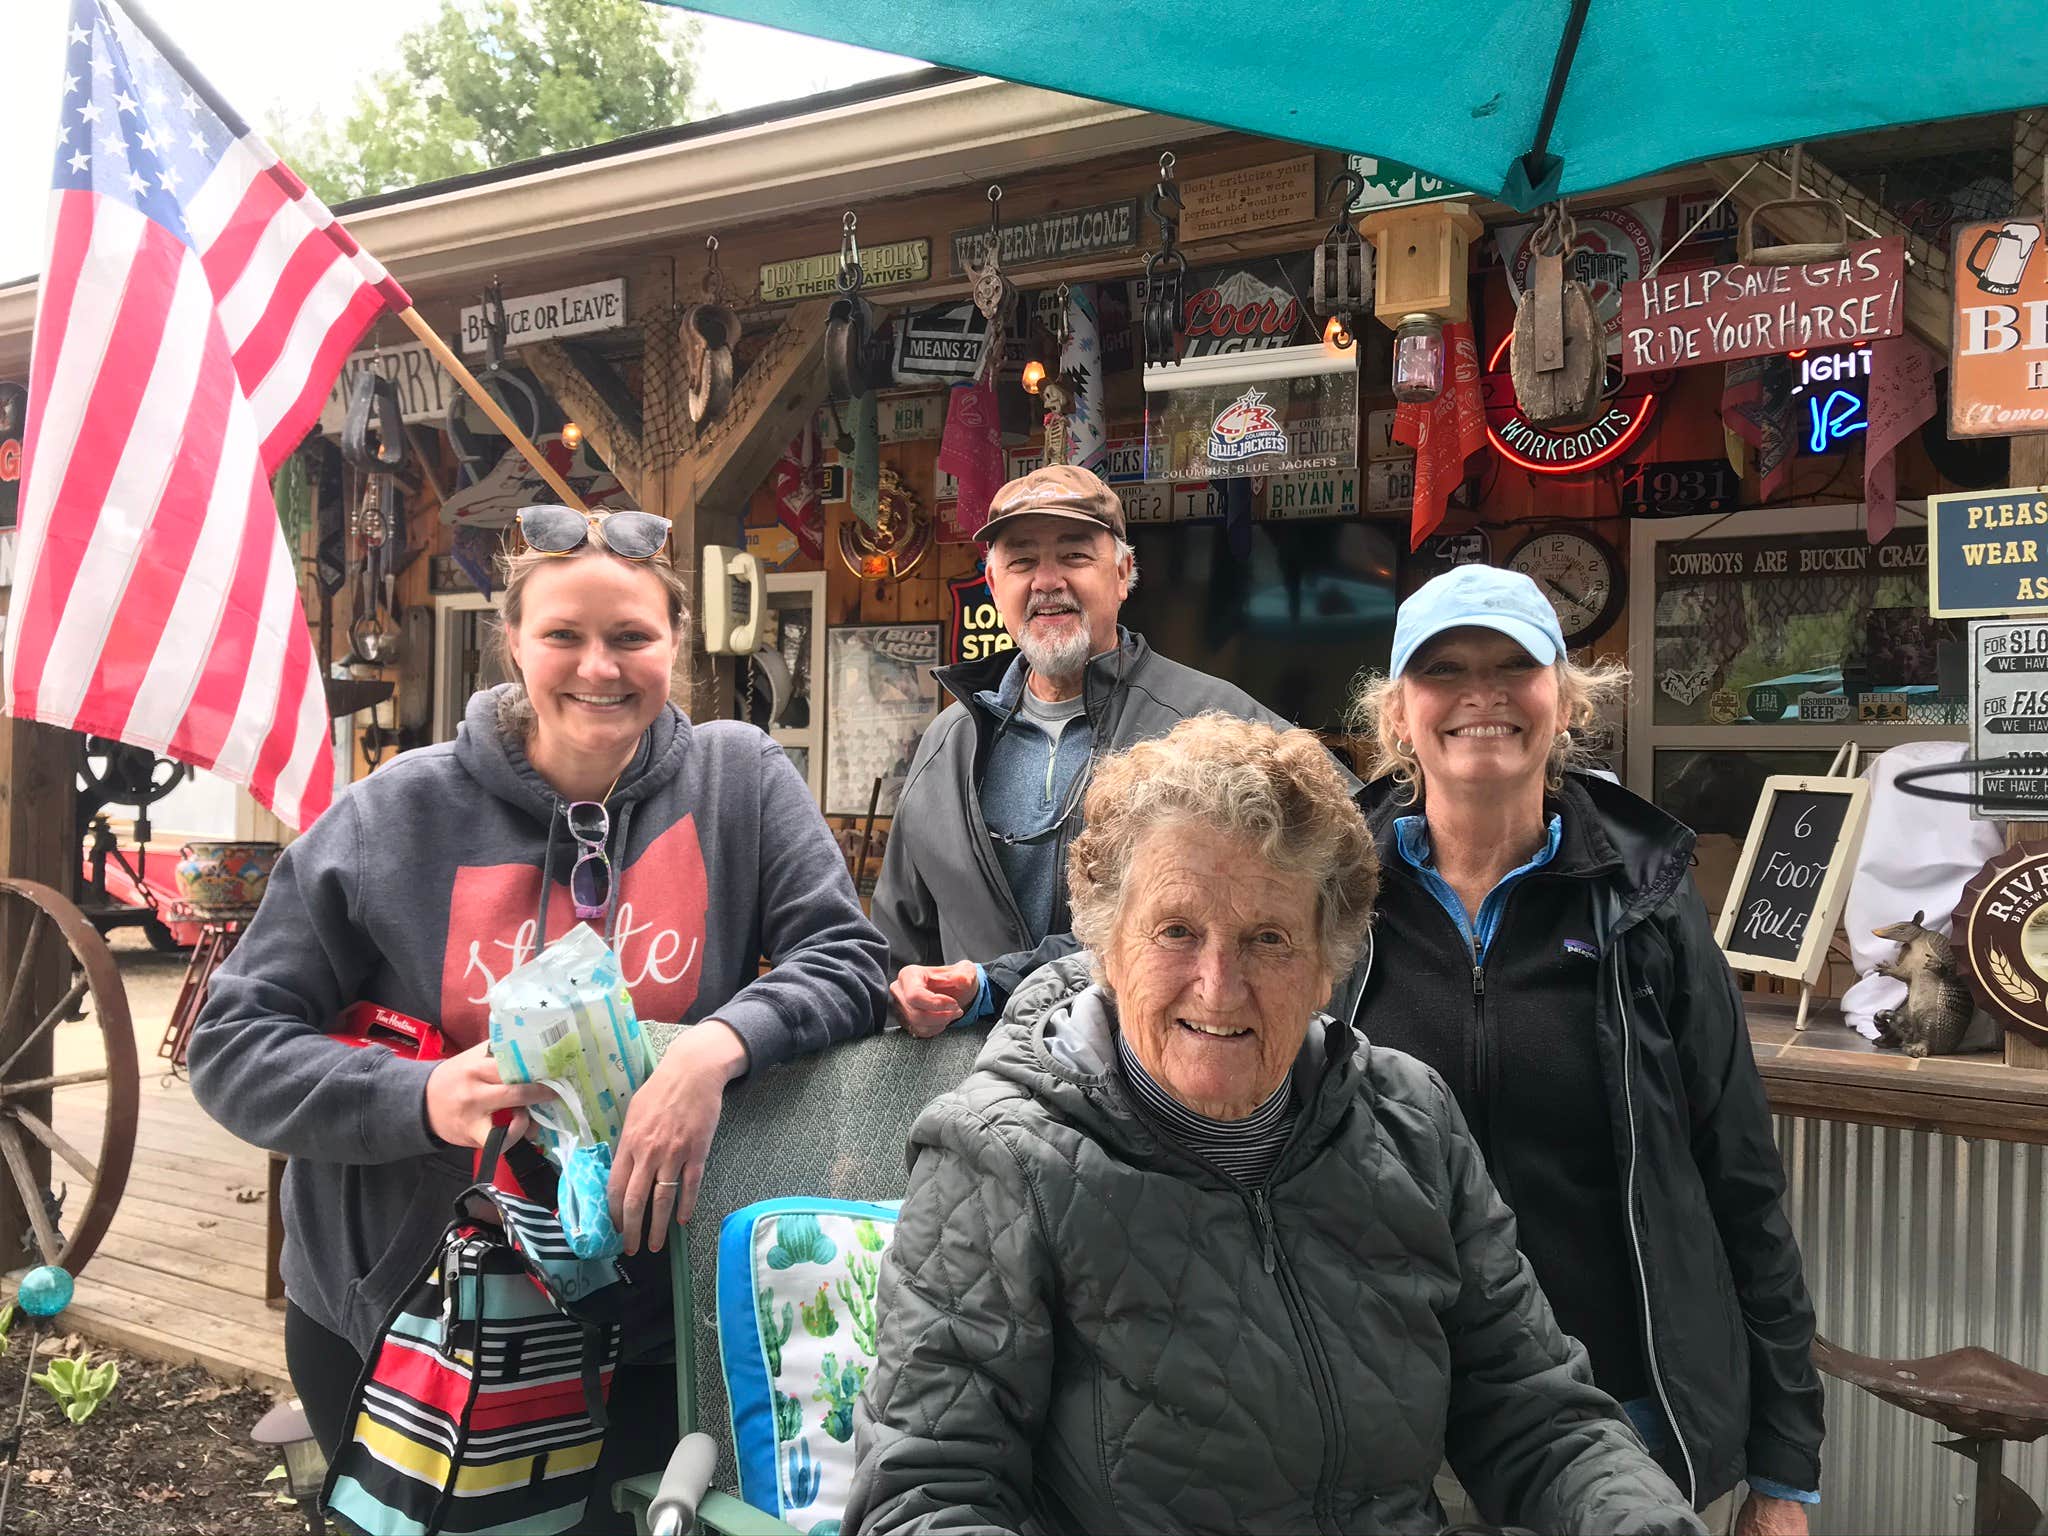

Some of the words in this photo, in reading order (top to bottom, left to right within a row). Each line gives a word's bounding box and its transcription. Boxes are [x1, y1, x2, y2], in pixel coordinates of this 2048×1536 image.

[1276, 161, 1309, 178] your
[1240, 185, 1262, 197] she
[1264, 179, 1295, 192] were
[1280, 190, 1308, 202] have
[955, 224, 1038, 268] WESERN
[1043, 206, 1130, 254] WELCOME
[763, 261, 812, 294] DON'T
[816, 249, 869, 280] JUE
[872, 241, 926, 272] FOLKS
[1575, 251, 1629, 292] STATE
[776, 284, 793, 298] BY
[798, 279, 837, 295] THEIR
[840, 267, 912, 289] EATIVES
[1641, 269, 1722, 319] HELP
[1726, 264, 1791, 301] SAVE
[1801, 248, 1882, 287] GAS
[533, 301, 560, 330] OR
[561, 292, 617, 325] LEAVE
[1184, 287, 1298, 337] Coors
[1706, 311, 1776, 353] YOUR
[909, 338, 960, 359] MEANS
[962, 342, 979, 360] 21
[1791, 349, 1873, 394] IGHT
[1289, 427, 1350, 456] TENDER
[1500, 408, 1631, 461] WORKBOOTS
[1210, 438, 1240, 459] BLUE
[1237, 437, 1286, 457] JACKETS
[1161, 465, 1229, 480] COLUMBUS
[1236, 462, 1270, 474] BLUE
[1278, 456, 1337, 470] JACKETS
[1298, 470, 1329, 480] OHIO
[1271, 480, 1334, 508] BRYAN
[1340, 479, 1354, 503] M
[1628, 467, 1731, 504] 1931
[1152, 497, 1162, 520] 2
[1968, 501, 2048, 529] PLEAS
[1533, 546, 1542, 557] 11
[1551, 541, 1565, 552] 12
[1962, 540, 2038, 566] WEAR
[1588, 560, 1599, 572] 2
[1668, 551, 1744, 576] COWBOYS
[1753, 549, 1788, 574] ARE
[1799, 546, 1873, 573] BUCKIN'
[1594, 579, 1604, 591] 3
[1585, 600, 1597, 615] 4
[1570, 614, 1580, 626] 5
[886, 629, 933, 644] BUD
[1984, 637, 2006, 654] FOR
[878, 641, 936, 659] LIGHT
[1998, 657, 2017, 670] WE
[1755, 693, 1778, 709] IPA
[1800, 705, 1834, 720] BEER
[1984, 698, 2006, 715] FOR
[2001, 719, 2021, 732] WE
[1986, 780, 2006, 792] WE
[2010, 779, 2039, 792] HAVE
[1794, 804, 1818, 839] 6
[1759, 849, 1829, 890] FOOT
[463, 902, 698, 1005] stte
[375, 1008, 389, 1025] Tim
[388, 1014, 418, 1034] Hortons
